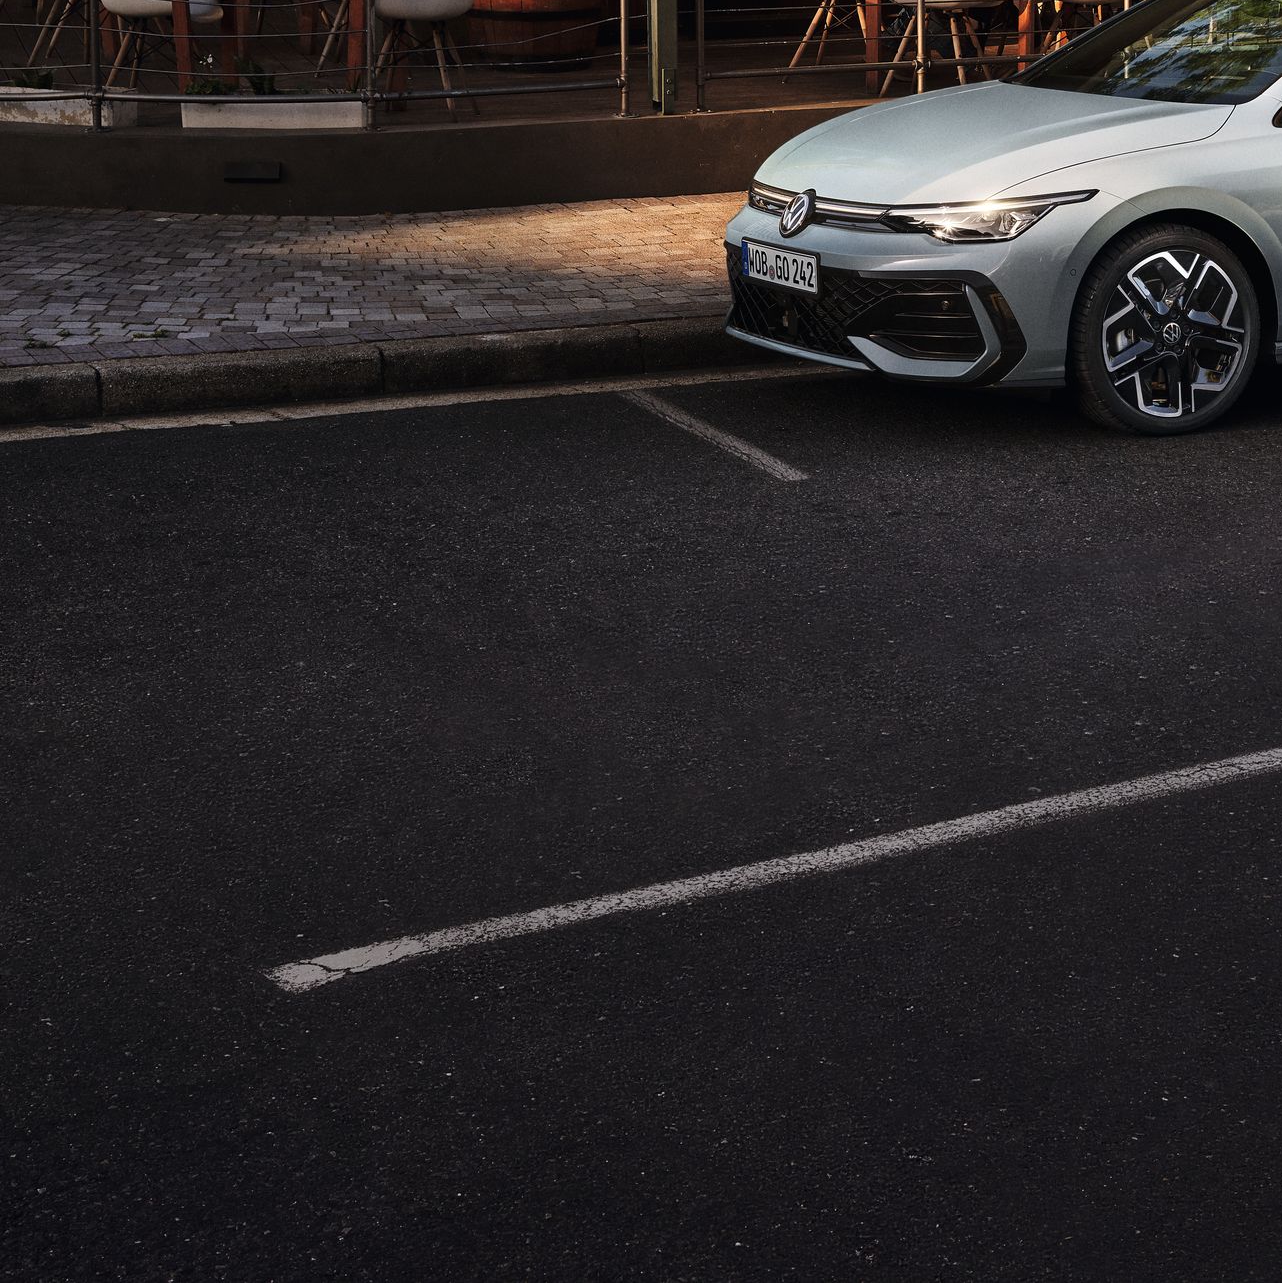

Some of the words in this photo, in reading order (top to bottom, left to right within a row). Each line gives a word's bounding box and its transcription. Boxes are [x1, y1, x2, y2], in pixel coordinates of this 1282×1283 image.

[748, 247, 768, 276] WOB
[775, 254, 790, 282] GO
[792, 258, 814, 288] 242
